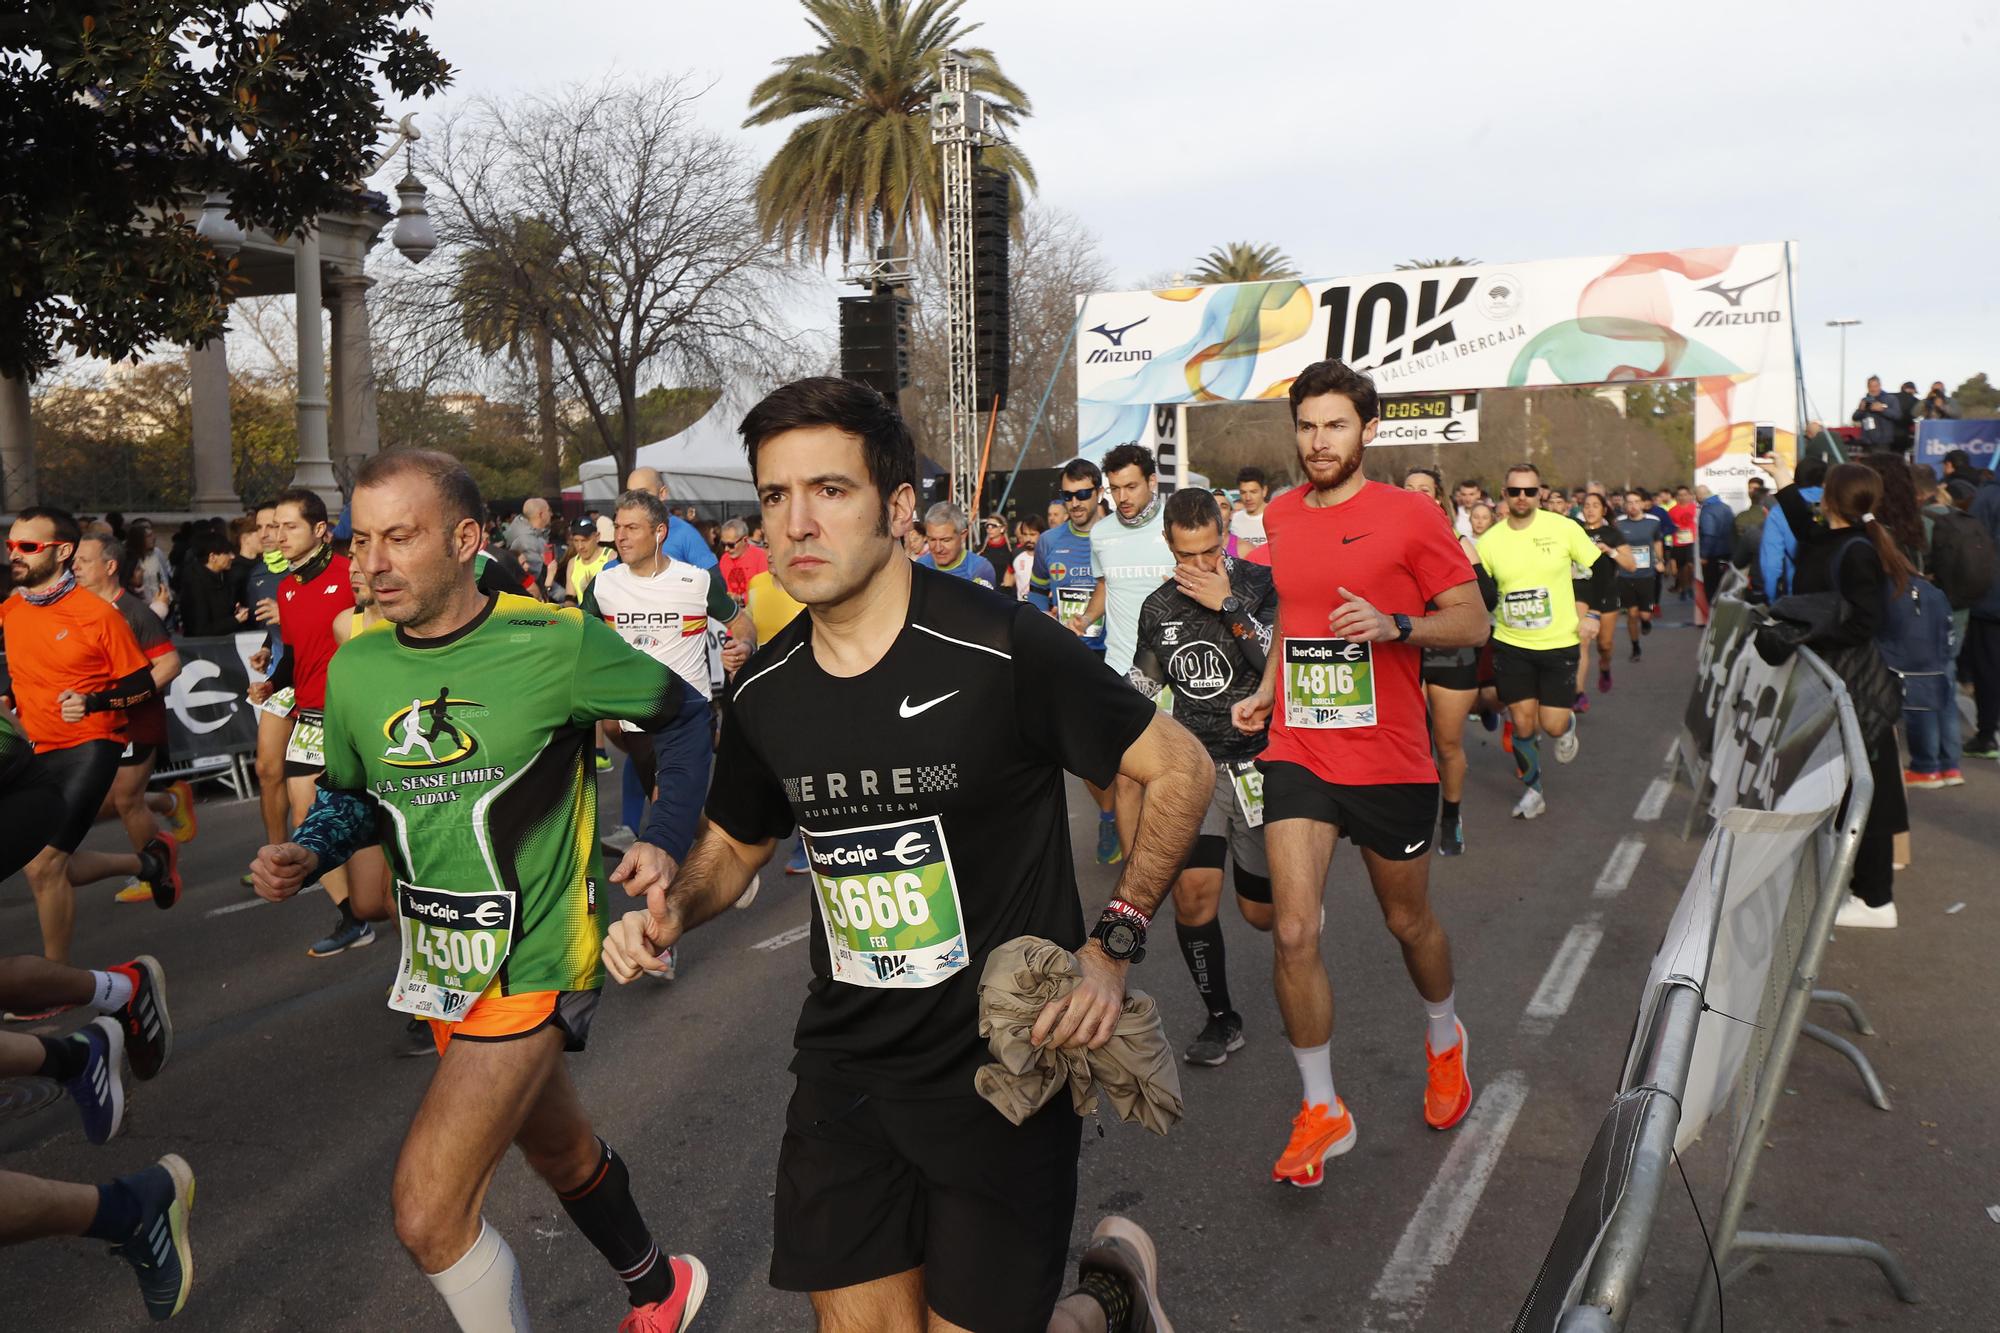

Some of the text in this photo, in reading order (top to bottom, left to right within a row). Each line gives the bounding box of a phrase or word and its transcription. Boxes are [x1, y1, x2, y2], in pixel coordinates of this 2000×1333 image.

[1086, 349, 1152, 364] MIZUNO
[1381, 323, 1526, 382] VALENCIA IBERCAJA
[1385, 401, 1446, 418] 0:06:40
[1511, 600, 1545, 617] 5045
[617, 612, 680, 624] DPAP
[1291, 646, 1333, 660] iberCaja
[1297, 664, 1354, 695] 4816
[401, 772, 448, 791] SENSE
[452, 766, 505, 786] LIMITS
[801, 767, 914, 802] ERRE
[805, 802, 918, 818] RUNNING TEAM
[821, 873, 929, 931] 3666
[416, 922, 496, 975] 4300
[869, 936, 888, 948] FER
[408, 983, 427, 994] BOX 6
